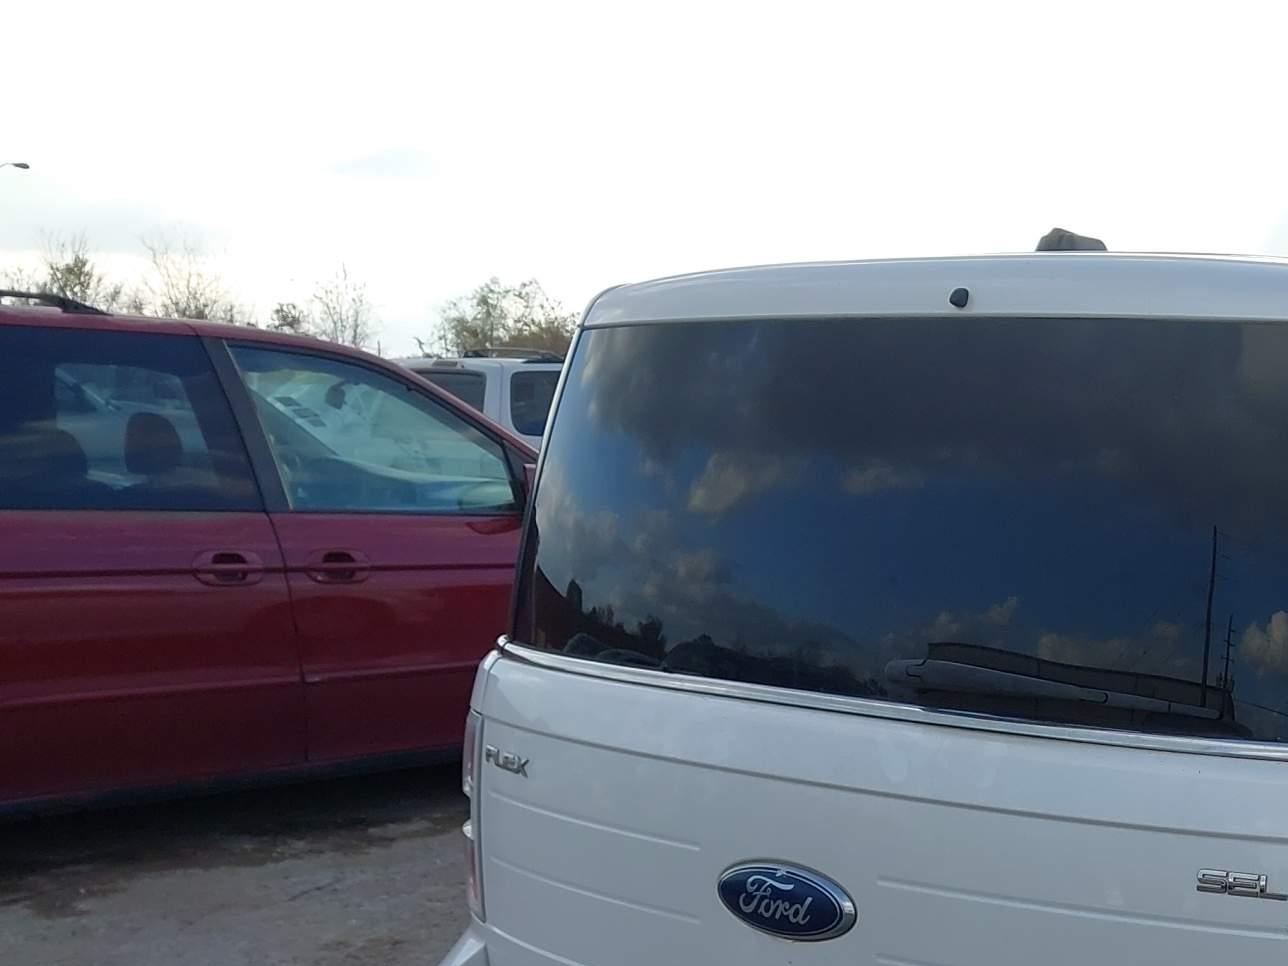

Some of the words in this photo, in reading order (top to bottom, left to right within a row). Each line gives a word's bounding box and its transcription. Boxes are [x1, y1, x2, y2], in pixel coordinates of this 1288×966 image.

[486, 744, 529, 779] FLEX
[739, 875, 813, 924] Ford
[1197, 868, 1288, 901] SEL
